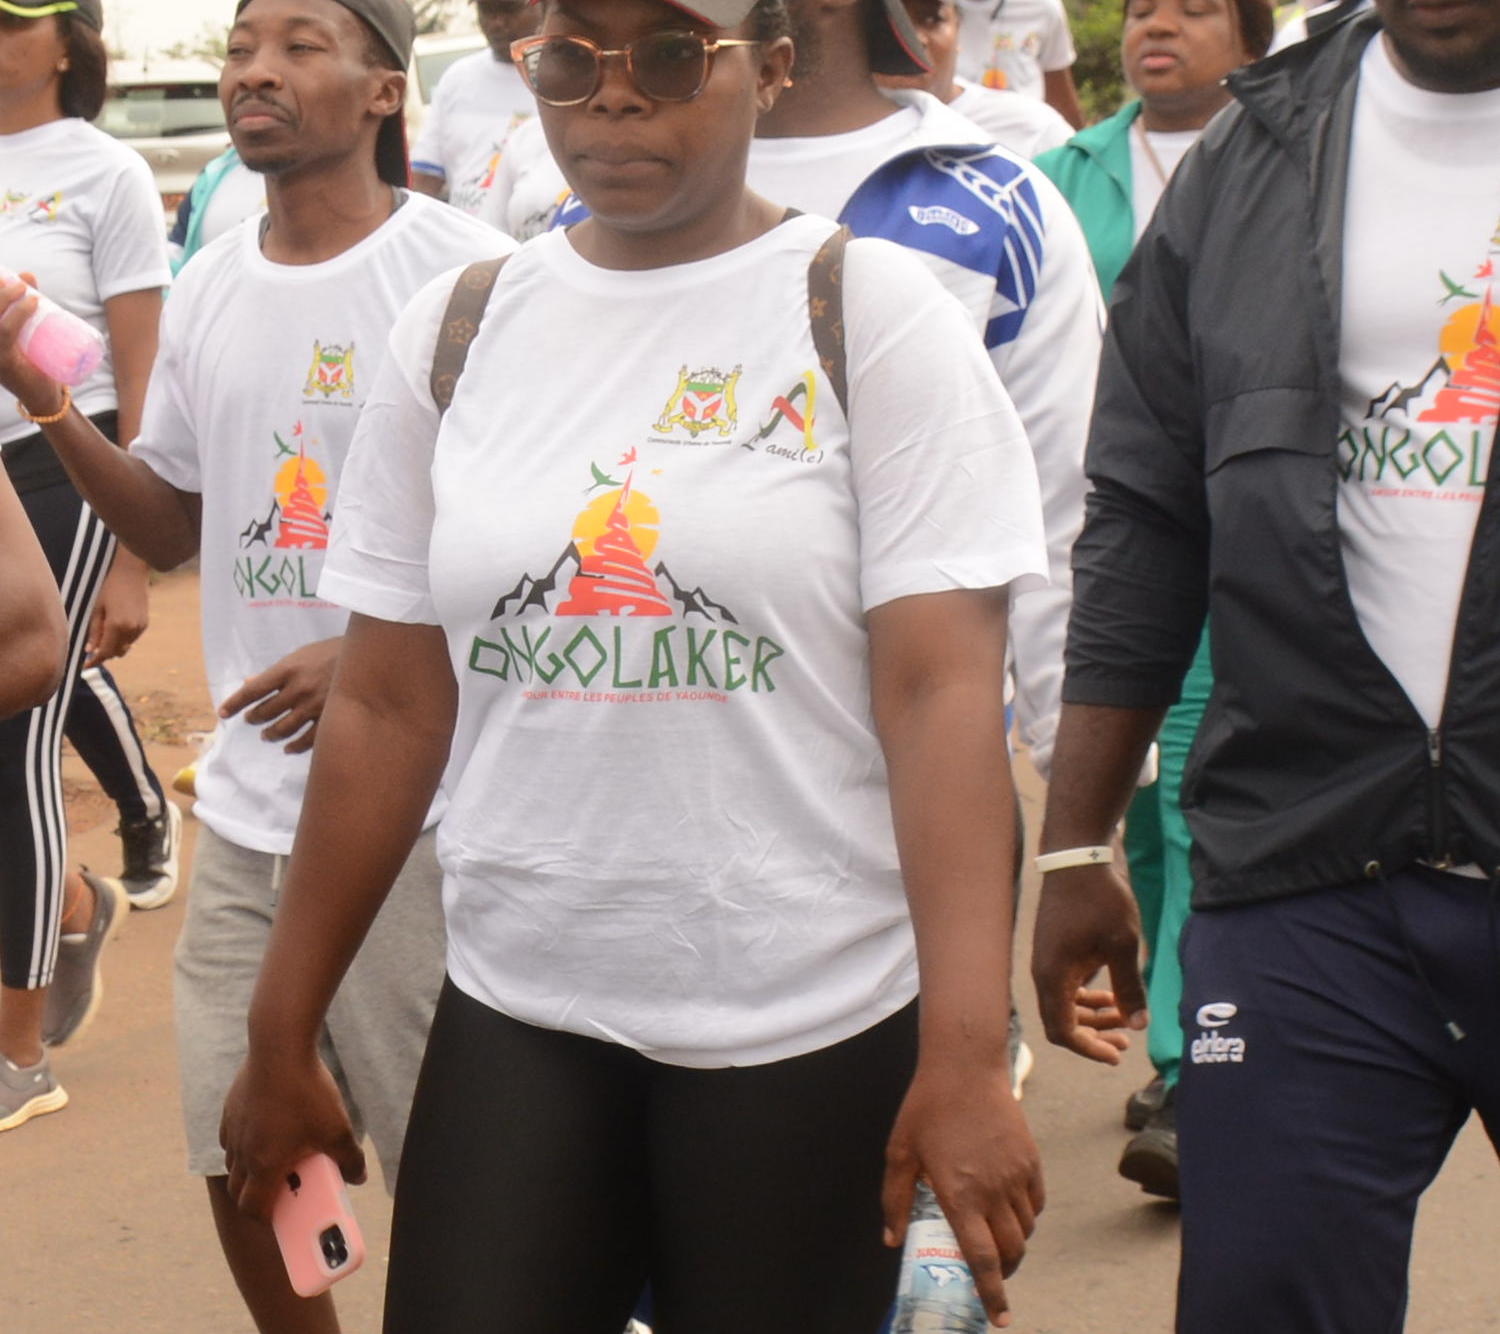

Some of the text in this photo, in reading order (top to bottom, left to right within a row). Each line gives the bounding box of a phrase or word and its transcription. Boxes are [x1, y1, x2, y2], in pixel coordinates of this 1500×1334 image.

[468, 624, 786, 693] ONGOLAKER
[551, 691, 581, 702] ENTRE
[584, 692, 601, 702] LES
[604, 692, 653, 704] PEUPLES
[656, 692, 672, 703] DE
